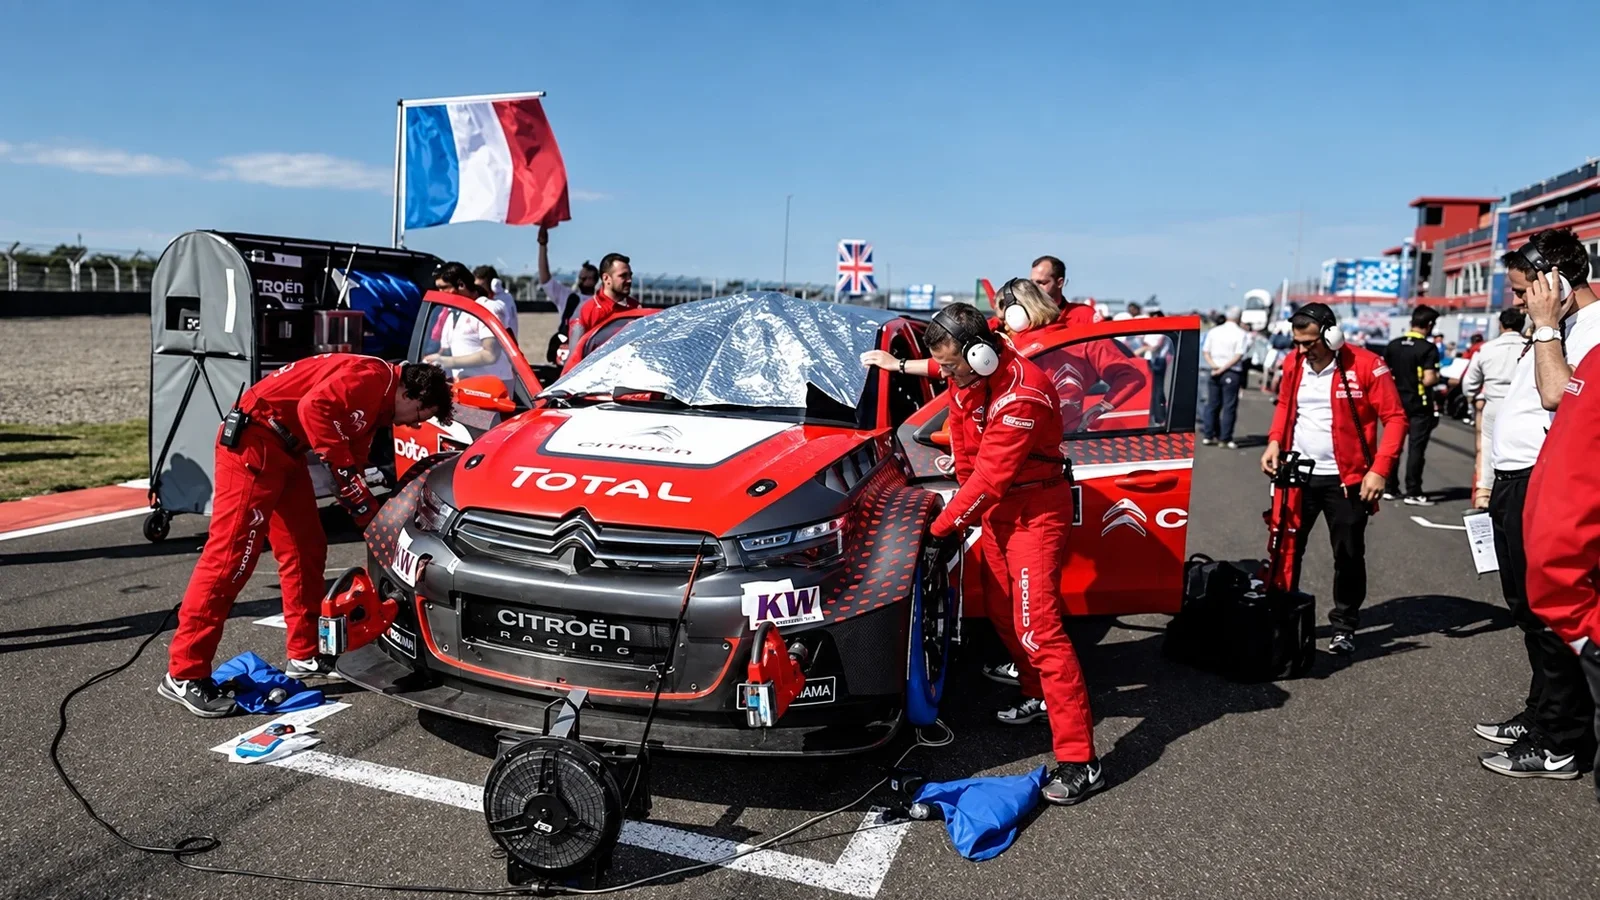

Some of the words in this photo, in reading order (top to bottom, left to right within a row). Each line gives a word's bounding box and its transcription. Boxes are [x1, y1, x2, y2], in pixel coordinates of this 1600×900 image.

[511, 466, 693, 503] TOTAL
[756, 587, 818, 621] KW
[497, 609, 631, 642] CITROËN
[500, 630, 630, 655] RACING
